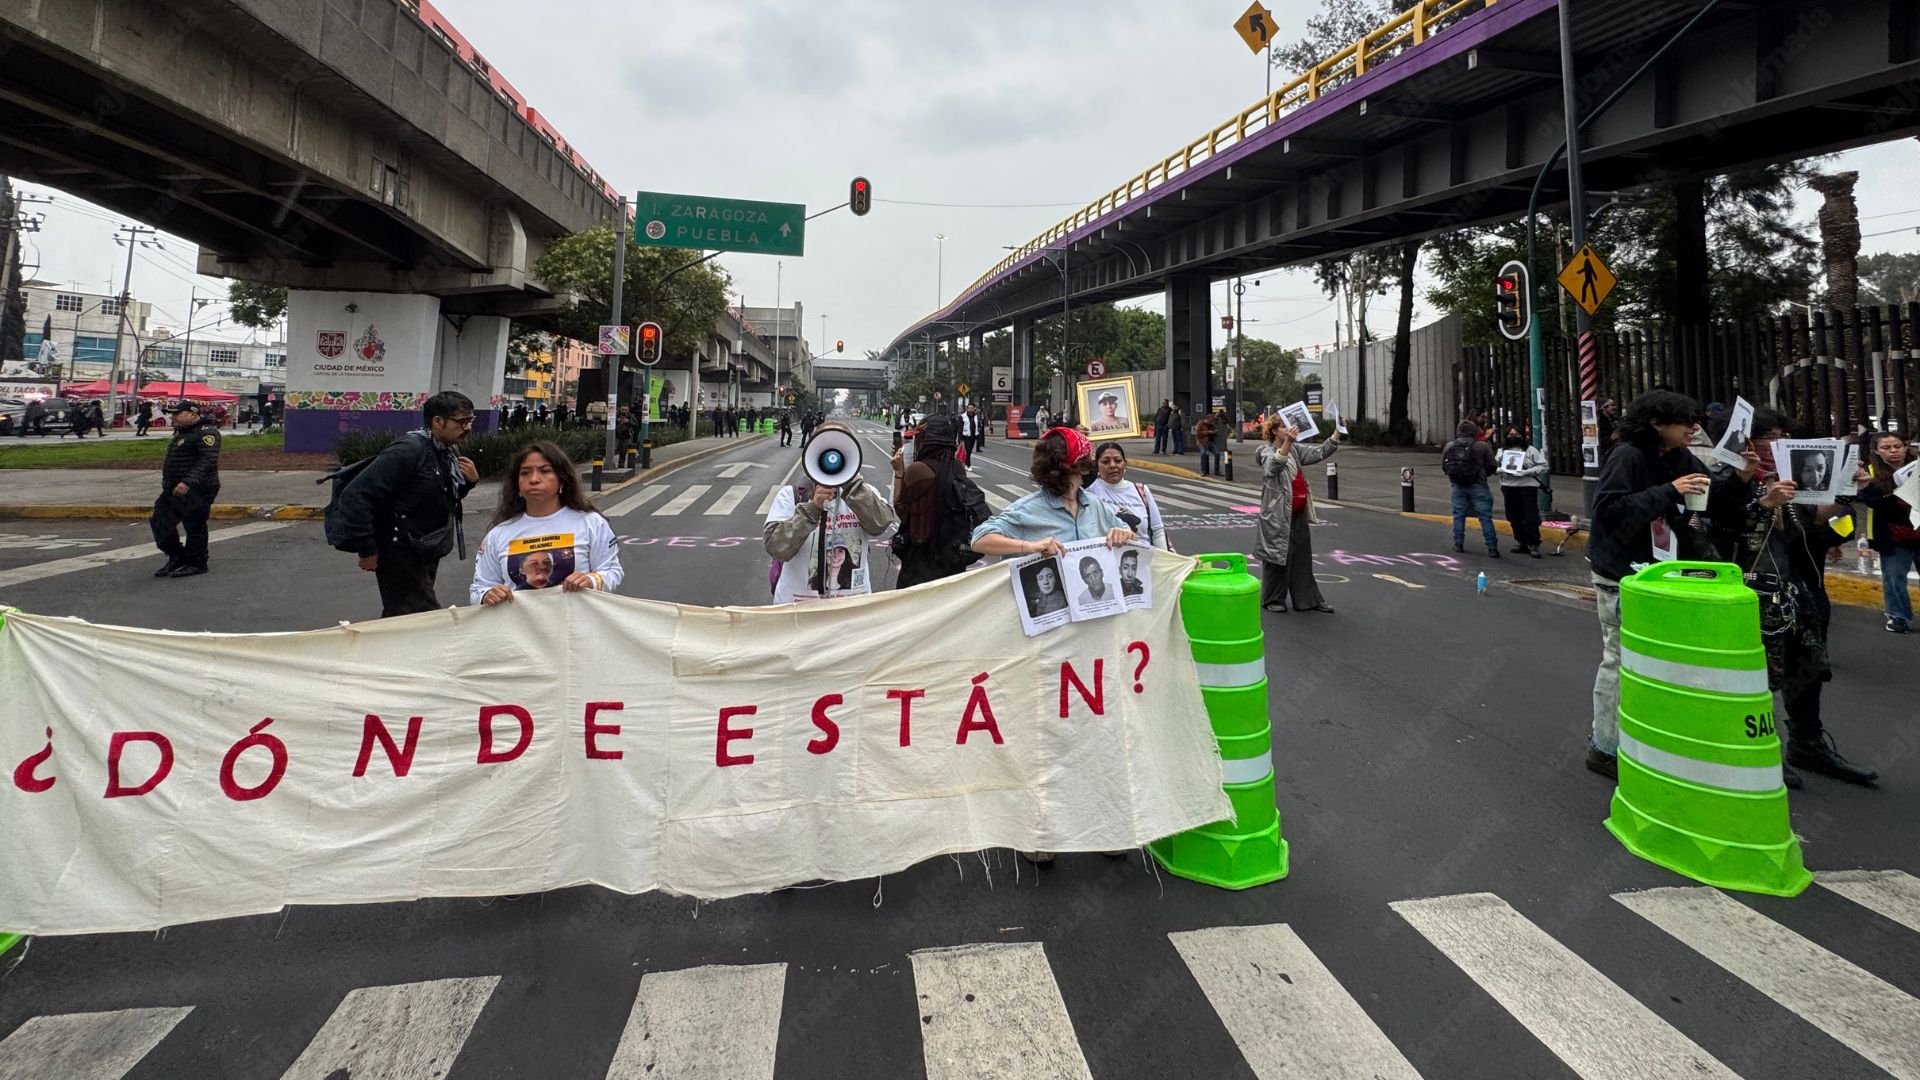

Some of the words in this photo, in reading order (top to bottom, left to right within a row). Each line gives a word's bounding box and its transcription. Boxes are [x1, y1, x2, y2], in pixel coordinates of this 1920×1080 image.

[671, 204, 769, 224] ZARAGOZA
[677, 226, 760, 244] PUEBLA
[355, 364, 385, 372] MÉXICO
[998, 377, 1006, 388] 6
[13, 702, 625, 801] ¿DÓNDE
[716, 641, 1150, 768] ESTÁN?
[1744, 711, 1776, 739] SAL
